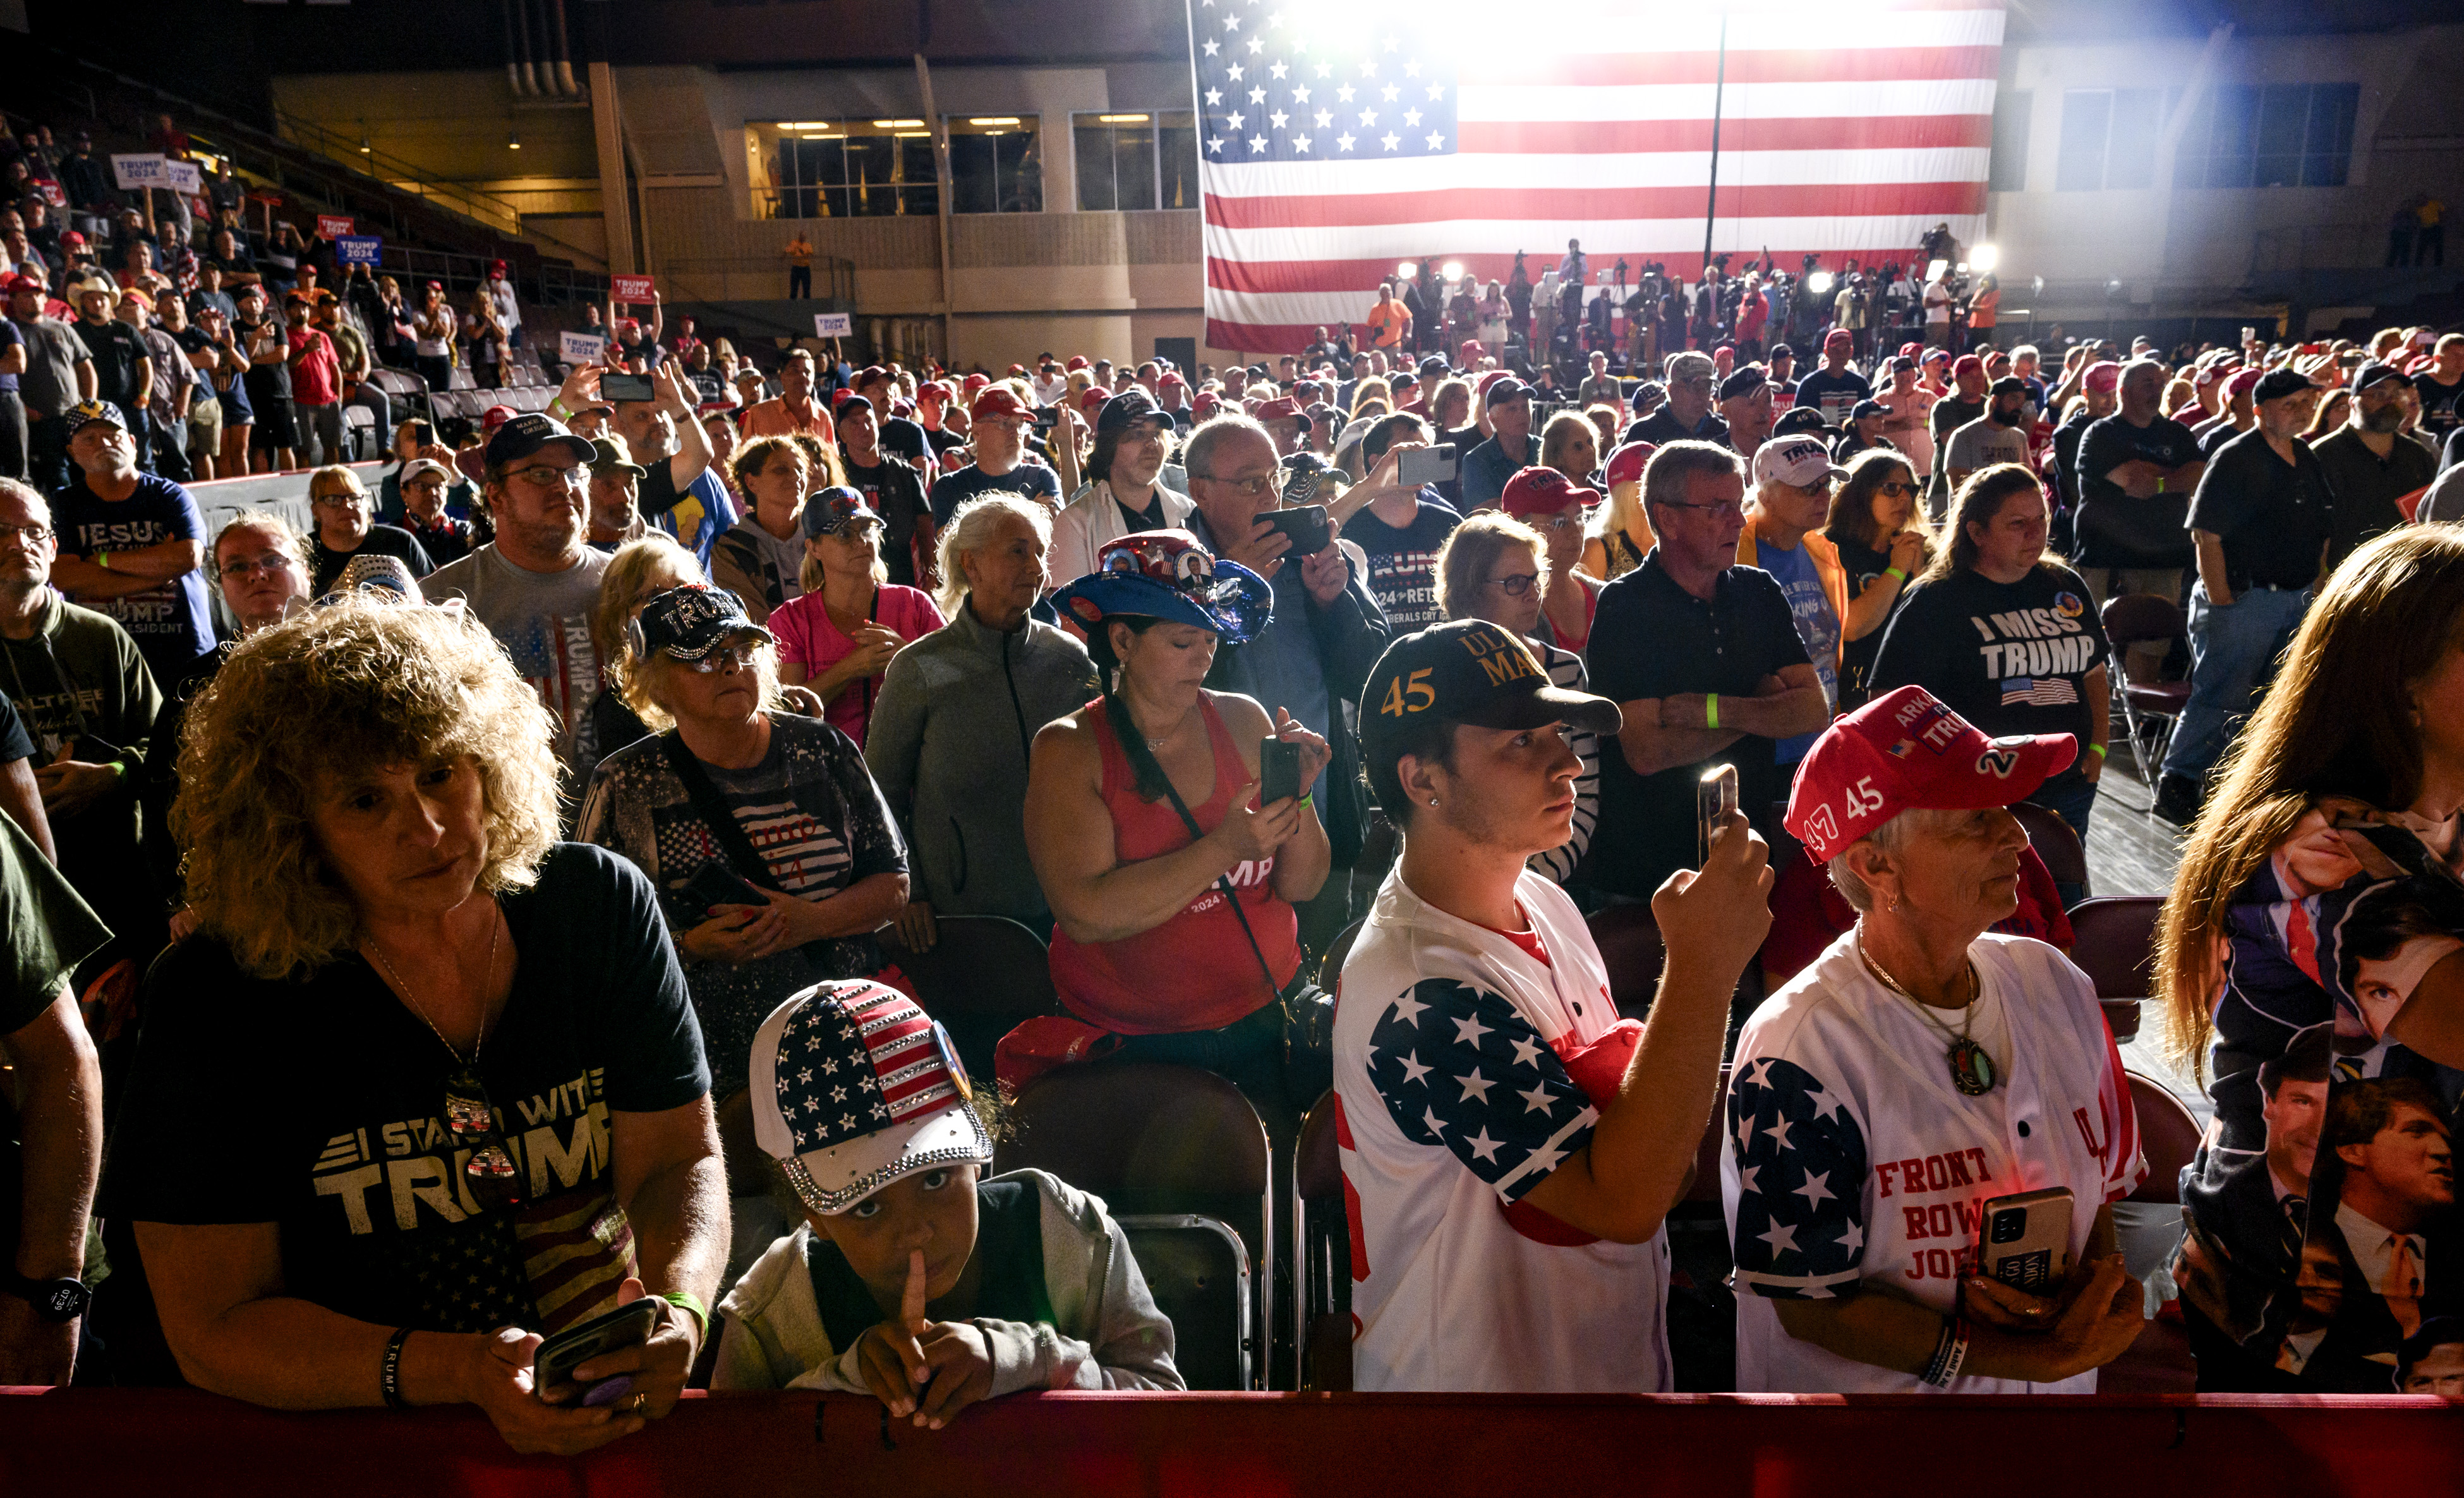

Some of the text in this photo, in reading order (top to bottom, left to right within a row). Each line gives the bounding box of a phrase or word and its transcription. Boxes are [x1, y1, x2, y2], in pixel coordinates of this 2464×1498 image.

[119, 161, 160, 169] TRUMP
[341, 241, 378, 250] TRUMP
[620, 287, 646, 295] 2024
[565, 338, 600, 348] TRUMP
[571, 346, 595, 355] 2024
[1367, 550, 1438, 579] RUM
[1422, 610, 1437, 621] CRY
[1971, 608, 2082, 642] I MISS
[564, 612, 596, 692] TRUMP
[1980, 635, 2095, 680] TRUMP
[1477, 649, 1537, 687] MA
[1380, 667, 1435, 717] 45
[1804, 775, 1883, 852] 47 45
[1191, 895, 1220, 913] 2024
[358, 1127, 371, 1161] I
[1876, 1147, 1991, 1199] FRONT
[1902, 1197, 1983, 1240] ROW
[2005, 1261, 2020, 1276] GO
[54, 1290, 70, 1310] 07:39
[385, 1344, 400, 1392] TRUMP
